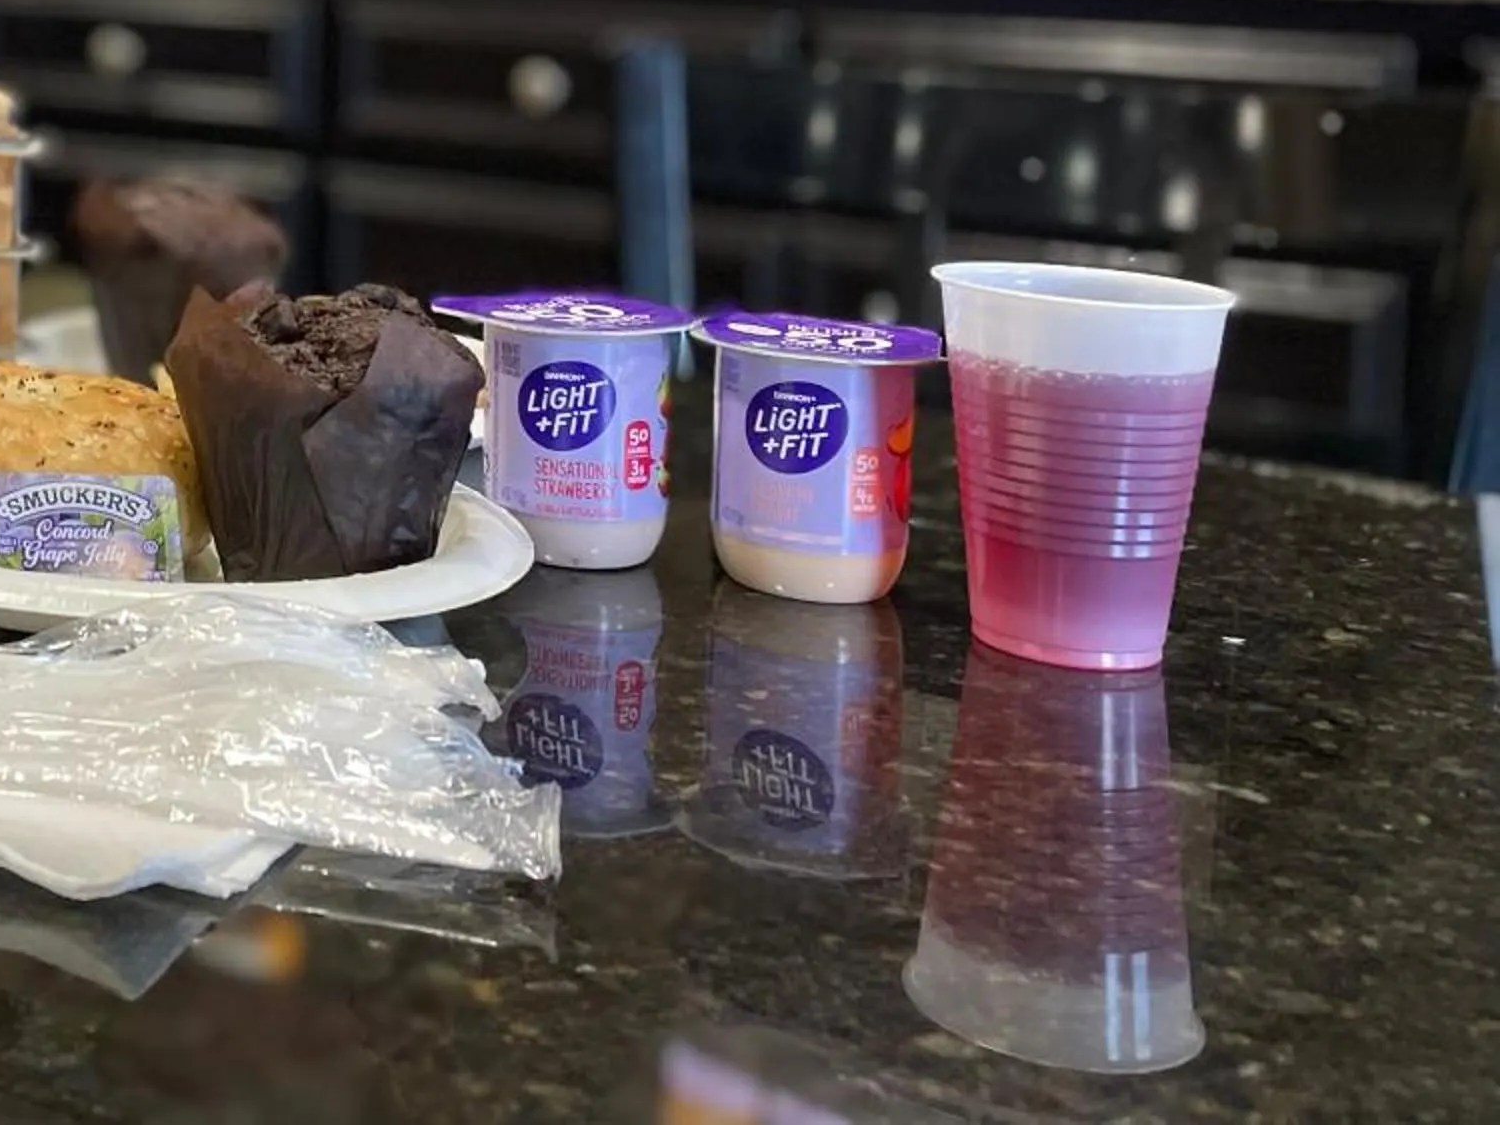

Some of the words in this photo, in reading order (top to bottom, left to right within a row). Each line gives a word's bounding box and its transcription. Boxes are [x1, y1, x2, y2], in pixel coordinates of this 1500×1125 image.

[629, 428, 649, 446] 50
[535, 457, 619, 480] SENSATIONAL
[857, 455, 878, 473] 50
[534, 479, 618, 500] STRAWBERRY
[7, 486, 140, 518] SMUCKER'S
[36, 519, 113, 540] Concord
[23, 541, 75, 568] Grape
[80, 543, 127, 566] Jelly
